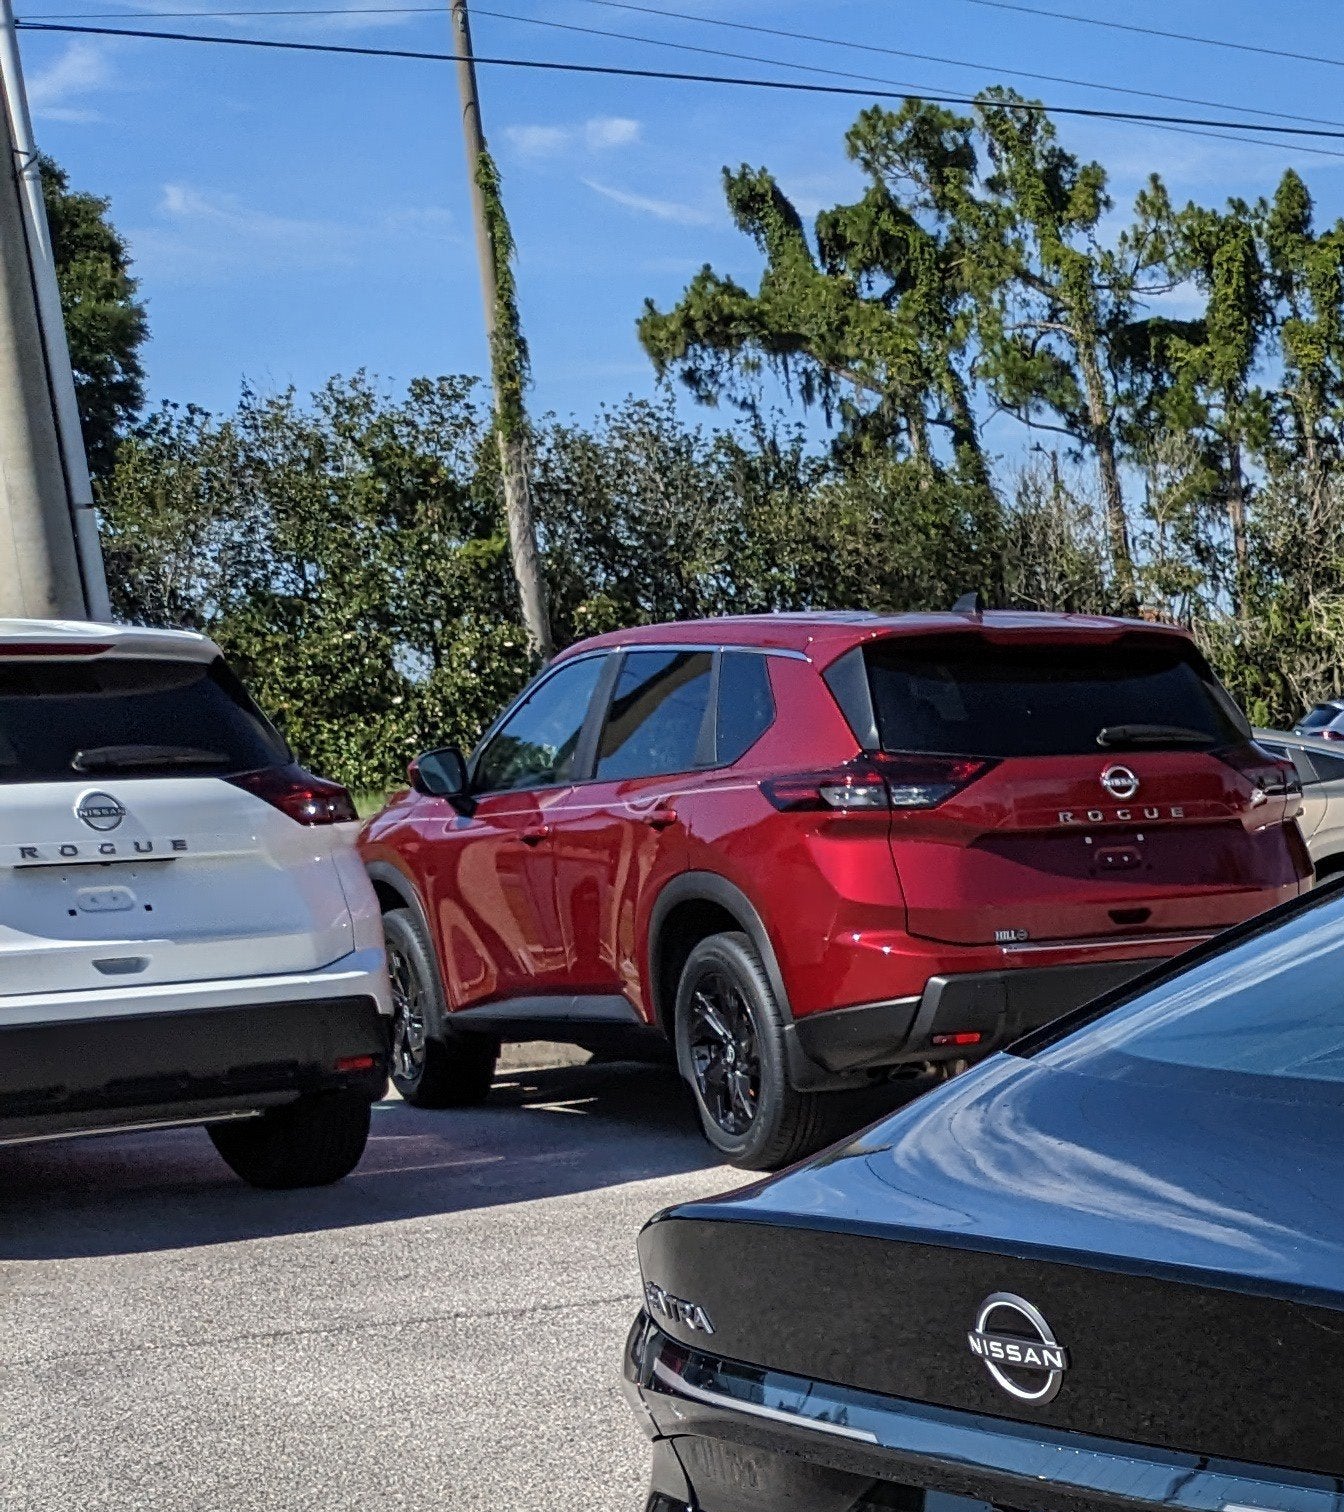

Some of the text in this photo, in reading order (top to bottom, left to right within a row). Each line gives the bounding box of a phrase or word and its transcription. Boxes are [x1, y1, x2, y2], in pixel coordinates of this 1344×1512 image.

[1059, 807, 1184, 823] ROGUE
[19, 839, 188, 859] ROGUE
[967, 1334, 1063, 1368] NISSAN
